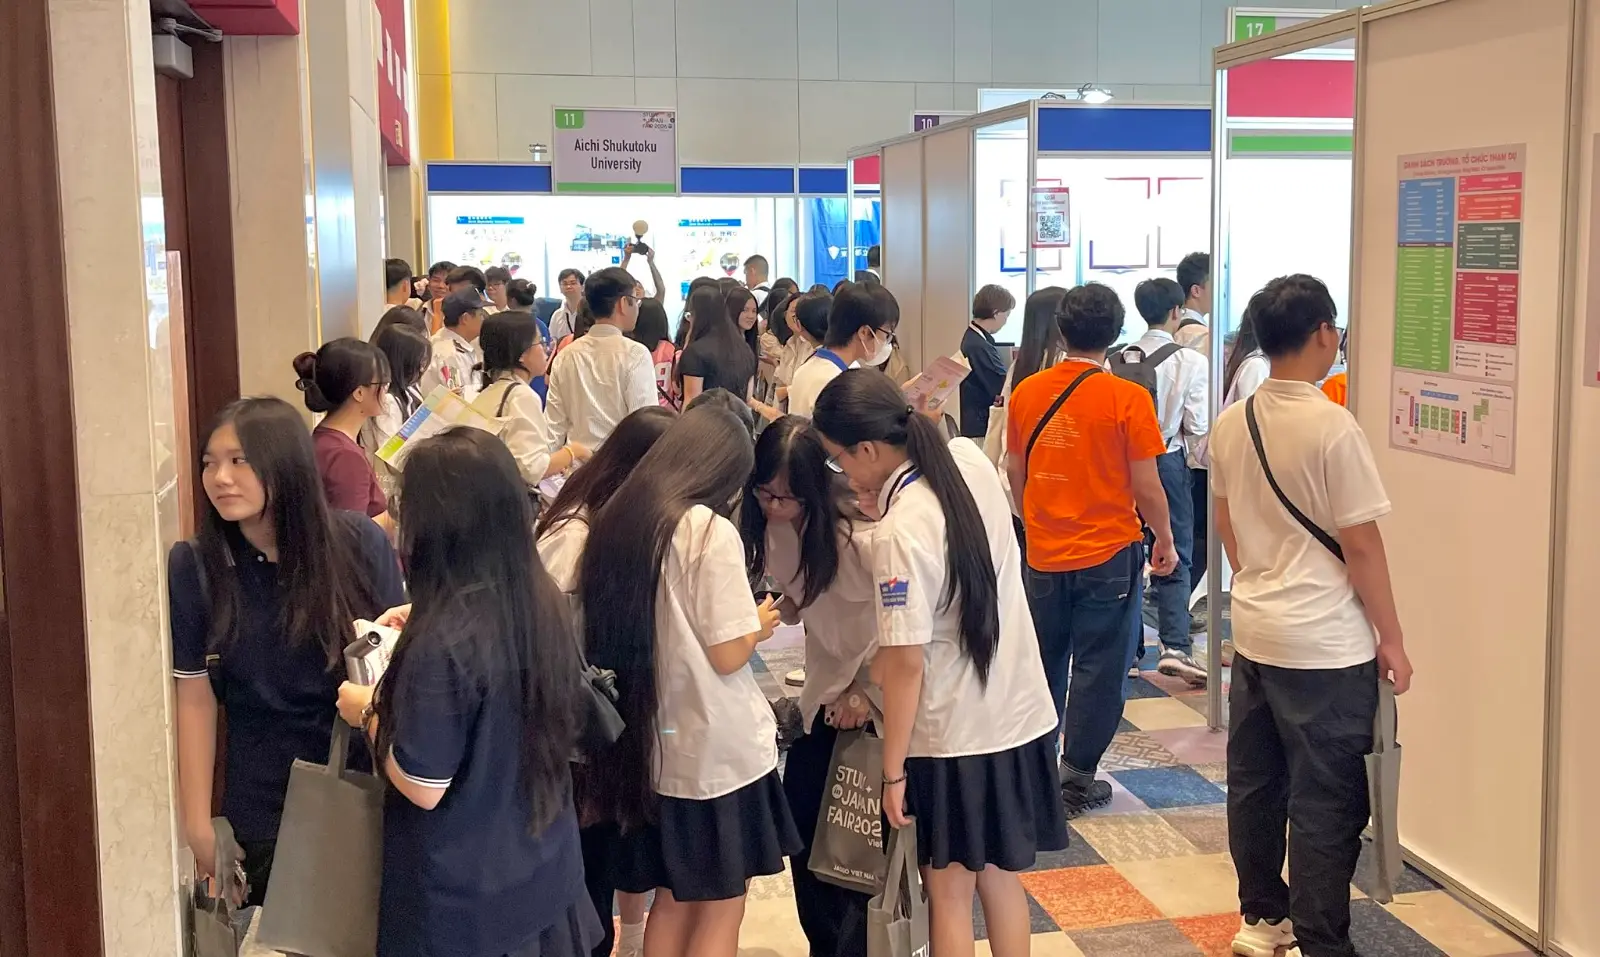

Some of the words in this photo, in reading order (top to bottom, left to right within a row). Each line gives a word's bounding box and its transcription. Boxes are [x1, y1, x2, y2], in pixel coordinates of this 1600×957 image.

[1246, 22, 1264, 38] 17
[564, 113, 575, 126] 11
[921, 118, 933, 130] 10
[574, 139, 600, 152] Aichi
[603, 139, 657, 153] Shukutoku
[591, 157, 642, 173] University
